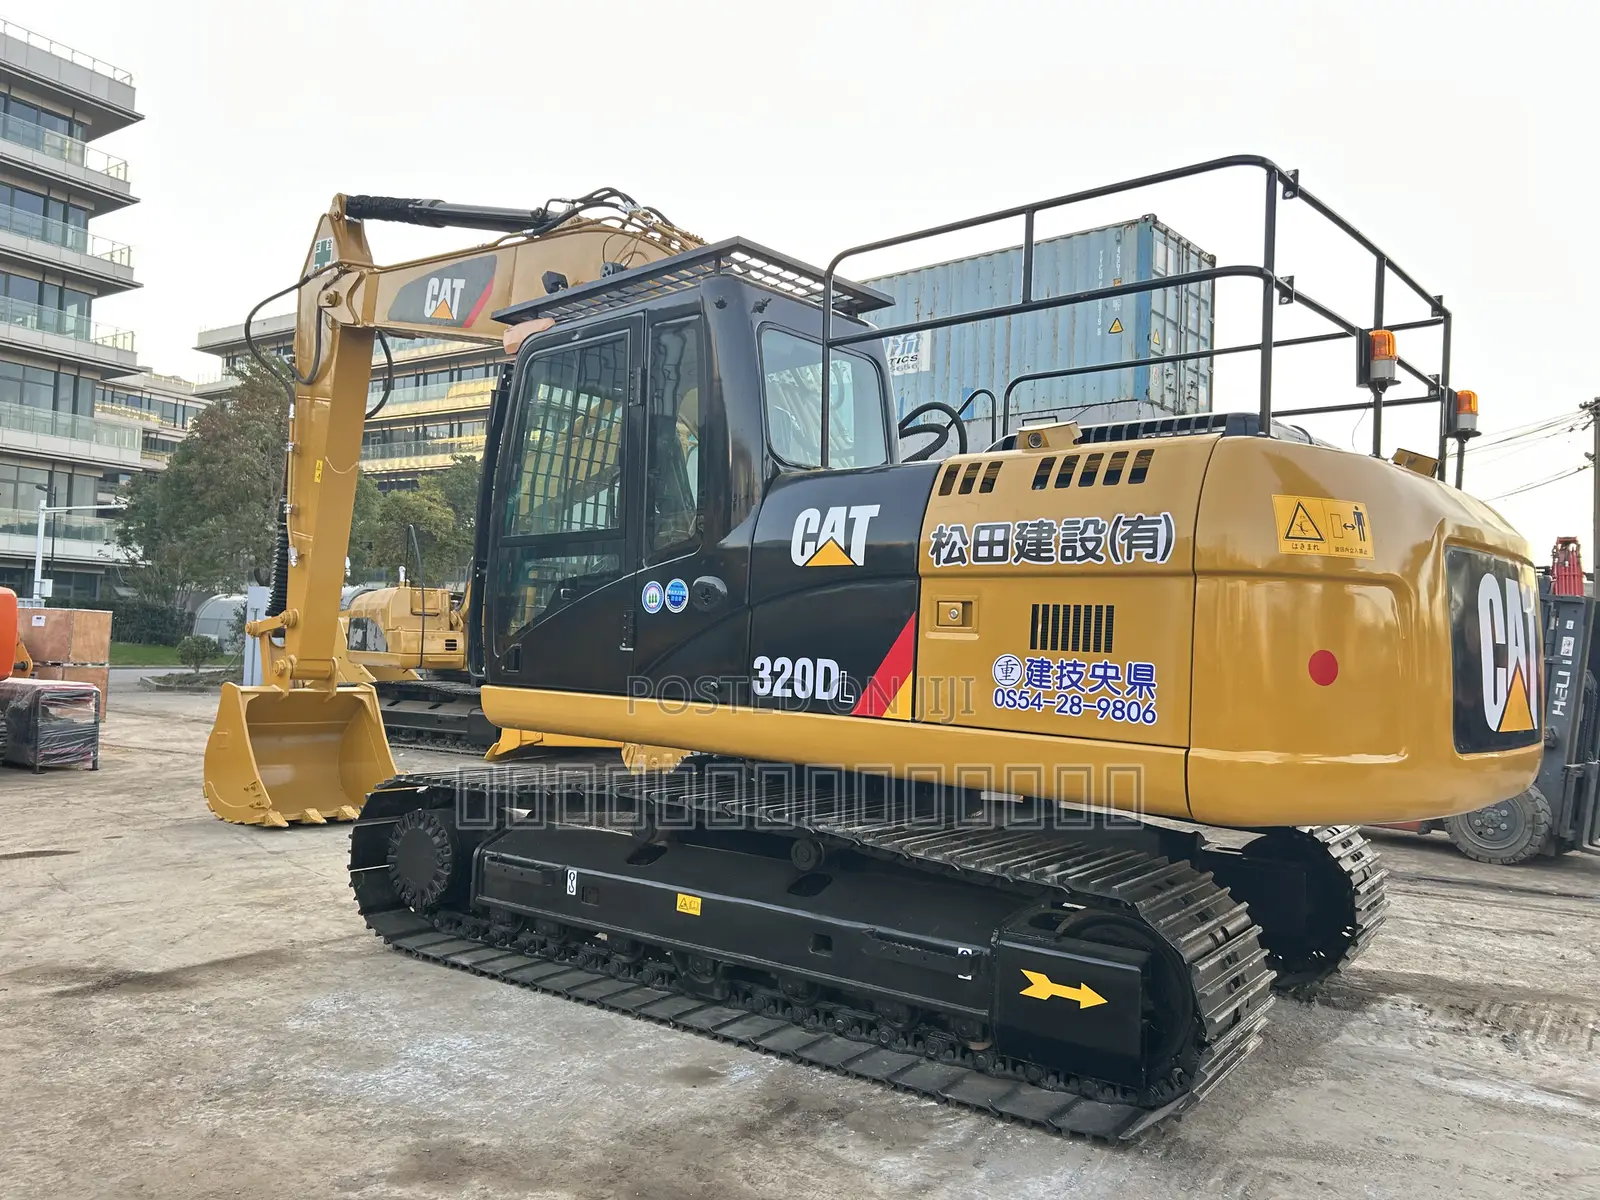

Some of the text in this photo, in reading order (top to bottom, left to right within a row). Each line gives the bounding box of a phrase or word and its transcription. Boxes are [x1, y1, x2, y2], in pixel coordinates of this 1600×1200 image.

[423, 277, 466, 320] CAT
[791, 504, 881, 567] CAT
[1478, 572, 1538, 732] CAT
